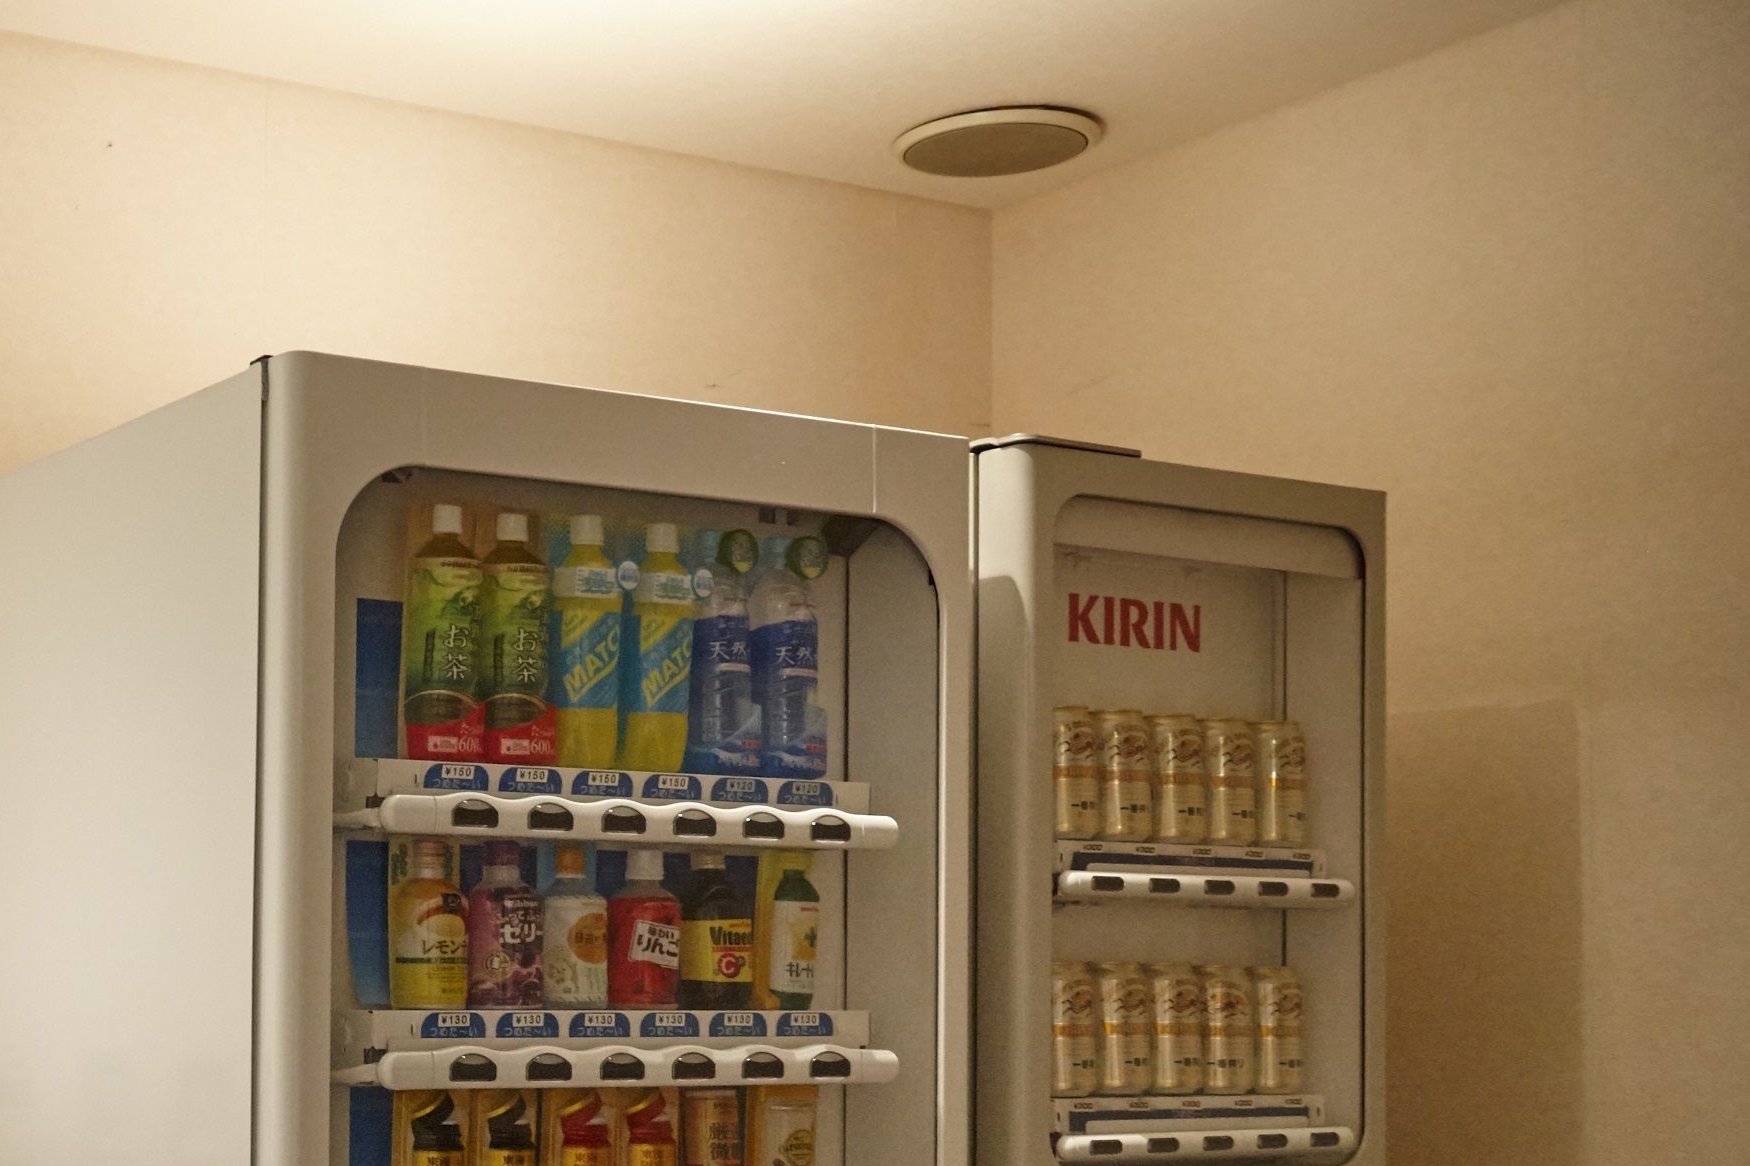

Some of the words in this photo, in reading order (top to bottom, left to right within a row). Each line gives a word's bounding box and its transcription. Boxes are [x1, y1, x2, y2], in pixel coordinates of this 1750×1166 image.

[1068, 593, 1201, 653] KIRIN
[442, 625, 469, 681] お茶
[512, 628, 538, 683] お茶
[441, 1015, 468, 1025] ¥130
[515, 1015, 541, 1025] ¥130
[588, 1014, 613, 1025] ¥130
[658, 1014, 683, 1025] ¥130
[727, 1014, 751, 1024] ¥130
[793, 1014, 817, 1024] ¥130
